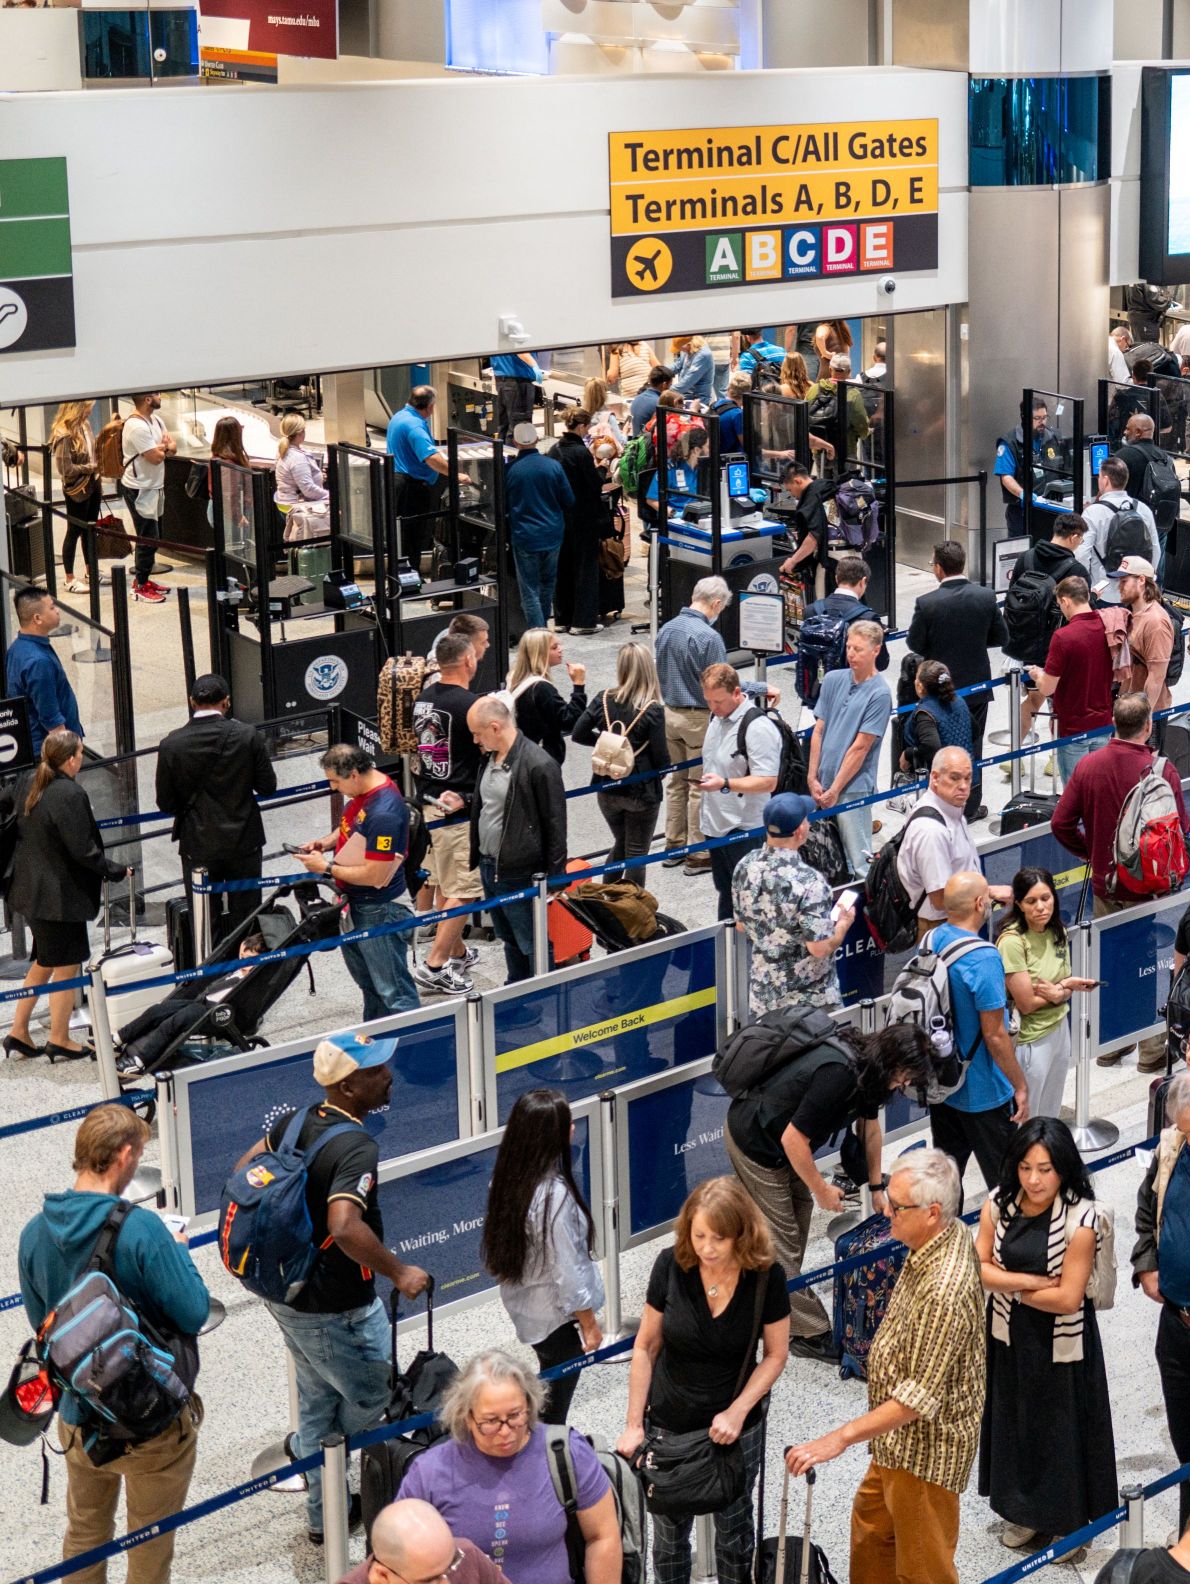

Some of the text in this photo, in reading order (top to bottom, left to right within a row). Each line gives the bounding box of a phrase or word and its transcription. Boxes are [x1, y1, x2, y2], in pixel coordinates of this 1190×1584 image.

[267, 14, 320, 27] mays.tamu.edu/mba
[624, 131, 928, 172] Terminal C/All Gates
[625, 176, 924, 224] Terminals A, B, D, E
[709, 225, 888, 273] A B C D E
[788, 266, 817, 274] TERMINAL
[826, 263, 854, 271] TERMINAL
[863, 259, 891, 268] TERMINAL
[709, 272, 739, 281] TERMINAL
[358, 735, 376, 756] Wait
[834, 937, 877, 961] CLEA
[260, 953, 281, 962] UNITED
[175, 970, 197, 980] UNITED
[1138, 966, 1156, 978] Less
[4, 990, 28, 999] UNITED
[572, 1013, 645, 1045] Welcome Back
[63, 1108, 87, 1120] CLEAR
[367, 1103, 390, 1115] LUS
[674, 1126, 724, 1155] Less Waiti
[400, 1215, 484, 1254] Waiting, More
[440, 1272, 480, 1290] clearme.com
[805, 1272, 827, 1284] UNITED
[0, 1297, 21, 1309] LEAR
[561, 1359, 588, 1374] UNITED
[239, 1479, 269, 1495] UNITED
[120, 1530, 151, 1547] UNITED
[1021, 1555, 1047, 1572] UNITED
